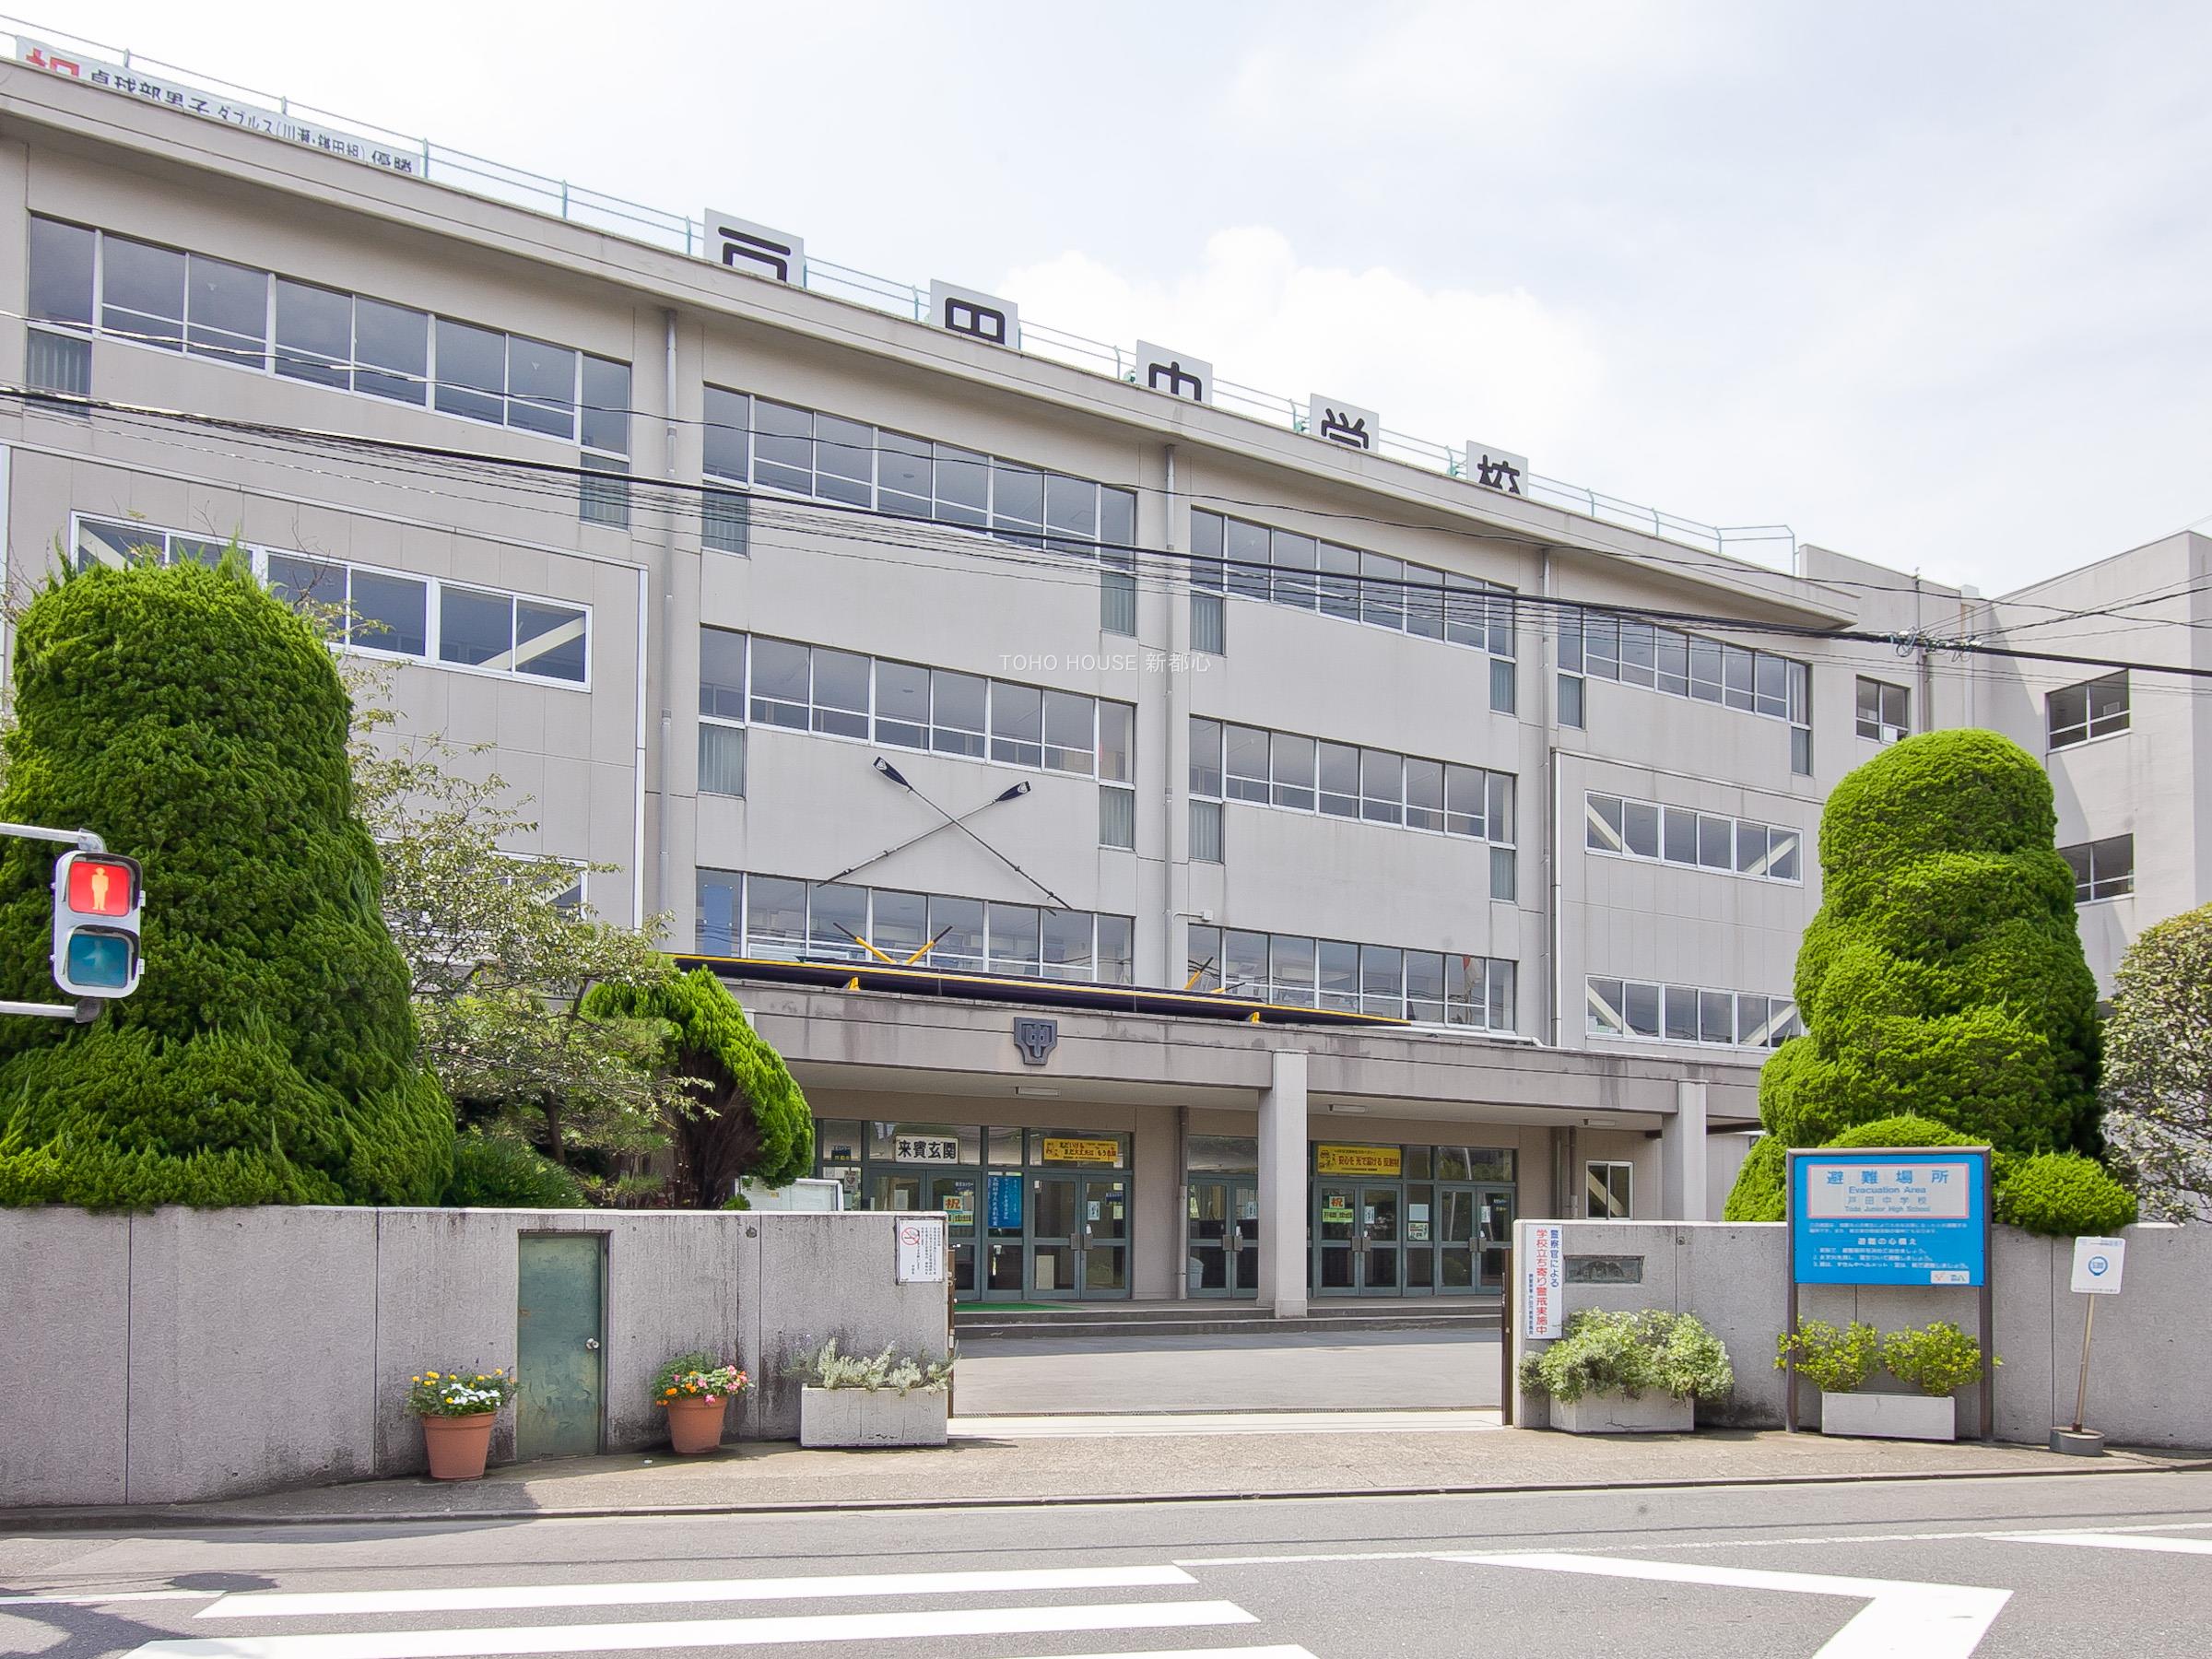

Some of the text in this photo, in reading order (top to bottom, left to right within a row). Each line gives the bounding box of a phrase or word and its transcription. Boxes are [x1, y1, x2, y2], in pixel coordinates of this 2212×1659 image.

[898, 1139, 957, 1159] 来賓玄関
[1826, 1168, 1949, 1185] 避難場所
[1848, 1185, 1927, 1194] Evacuation Area
[1550, 1230, 1559, 1288] 警察官による
